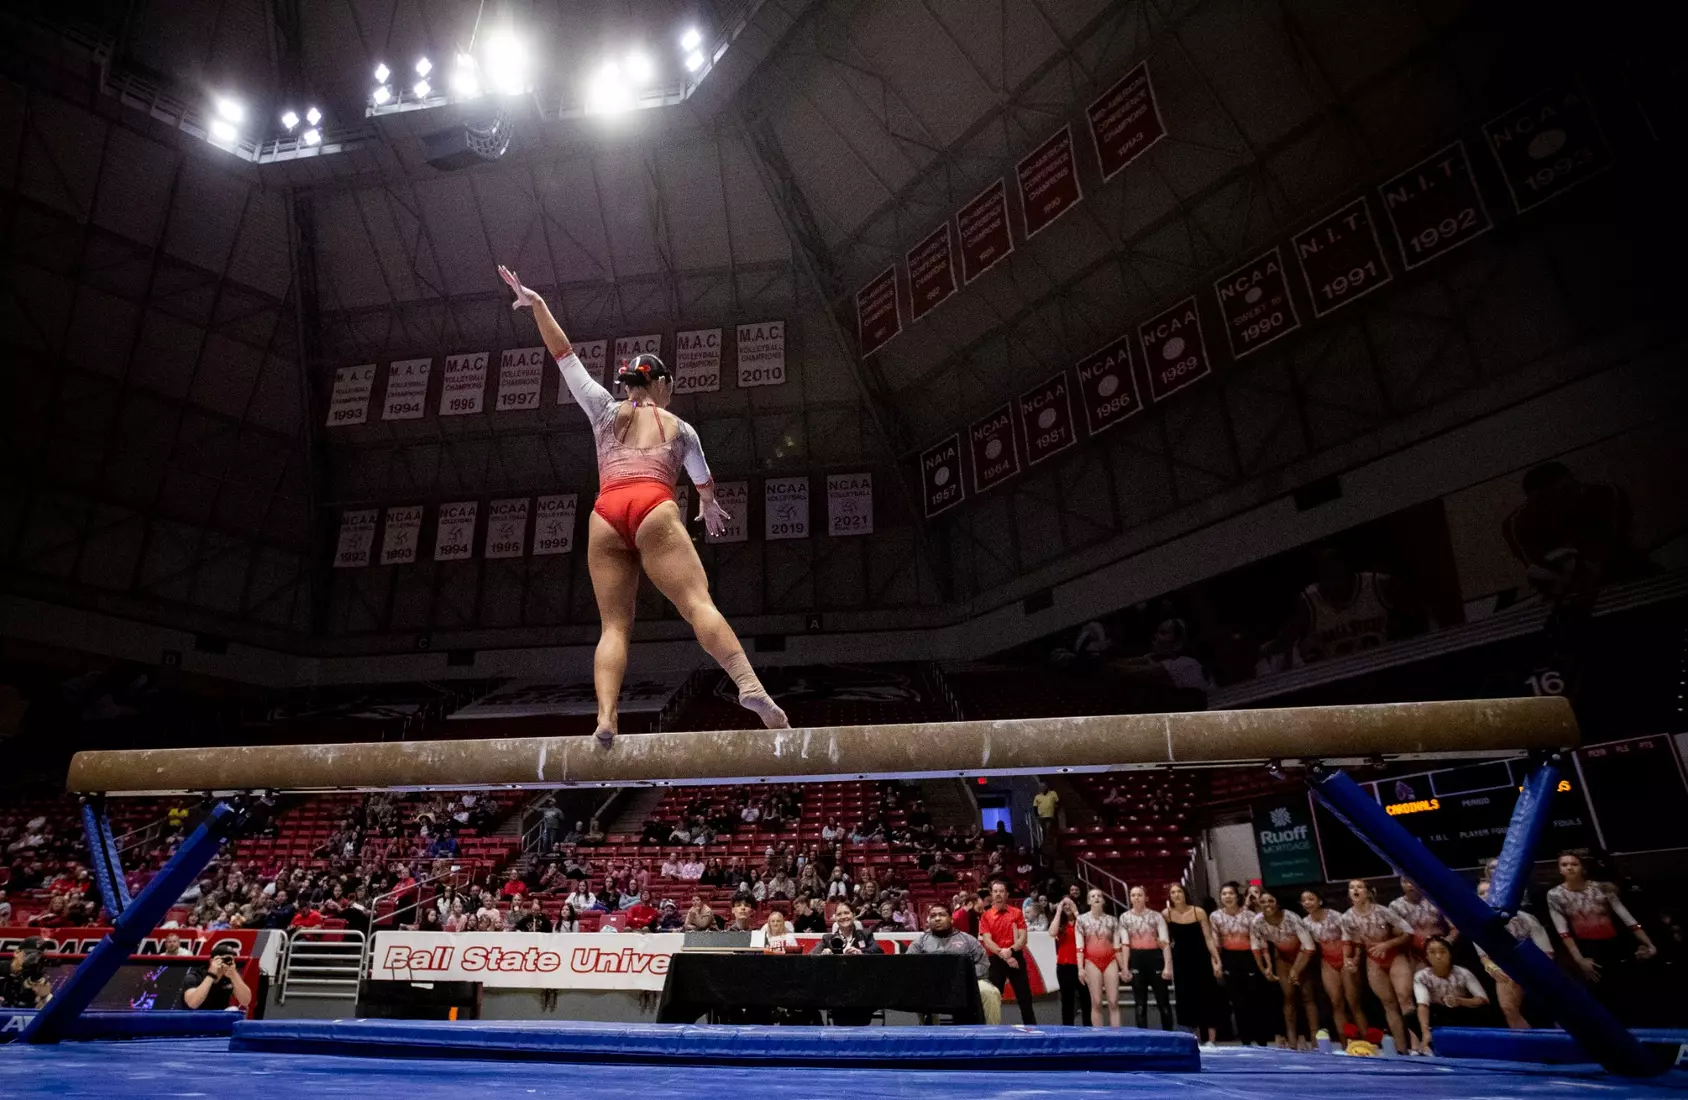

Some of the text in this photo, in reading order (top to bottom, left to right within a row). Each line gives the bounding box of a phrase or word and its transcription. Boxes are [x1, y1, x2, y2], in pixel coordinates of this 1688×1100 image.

[1493, 93, 1580, 148] NCAA
[1410, 208, 1477, 253] 1992
[1220, 262, 1279, 300] NCAA
[1321, 259, 1377, 299] 1991
[740, 326, 782, 342] M.A.C.
[1144, 310, 1196, 346] NCAA
[1241, 312, 1283, 344] 1990
[617, 340, 658, 354] M.A.C.
[679, 334, 719, 349] M.A.C.
[502, 352, 543, 367] M.A.C.
[1081, 349, 1127, 382] NCAA
[742, 367, 782, 382] 2010
[1161, 356, 1198, 384] 1989
[677, 374, 718, 388] 2002
[450, 398, 475, 411] 1996
[501, 392, 537, 405] 1997
[1023, 384, 1065, 415] NCAA
[389, 404, 419, 414] 1994
[1096, 394, 1130, 419] 1986
[334, 409, 362, 420] 1993
[974, 415, 1009, 441] NCAA
[1036, 428, 1066, 449] 1981
[926, 448, 955, 470] NAIA
[716, 487, 747, 498] CAA
[767, 484, 807, 493] NCAA
[830, 480, 871, 490] NCAA
[931, 484, 956, 504] 1957
[440, 507, 475, 518] NCAA
[490, 504, 526, 514] NCAA
[538, 500, 575, 510] NCAA
[342, 515, 375, 525] NCAA
[386, 511, 421, 522] NCAA
[834, 514, 867, 526] 2021
[772, 523, 804, 534] 2019
[440, 544, 468, 555] 1994
[540, 538, 567, 549] 1999
[810, 619, 820, 629] A
[1525, 671, 1565, 696] 16
[1385, 799, 1440, 816] CARDINALS
[1260, 824, 1308, 845] Ruoff
[383, 946, 455, 971] Ball
[461, 946, 561, 972] State
